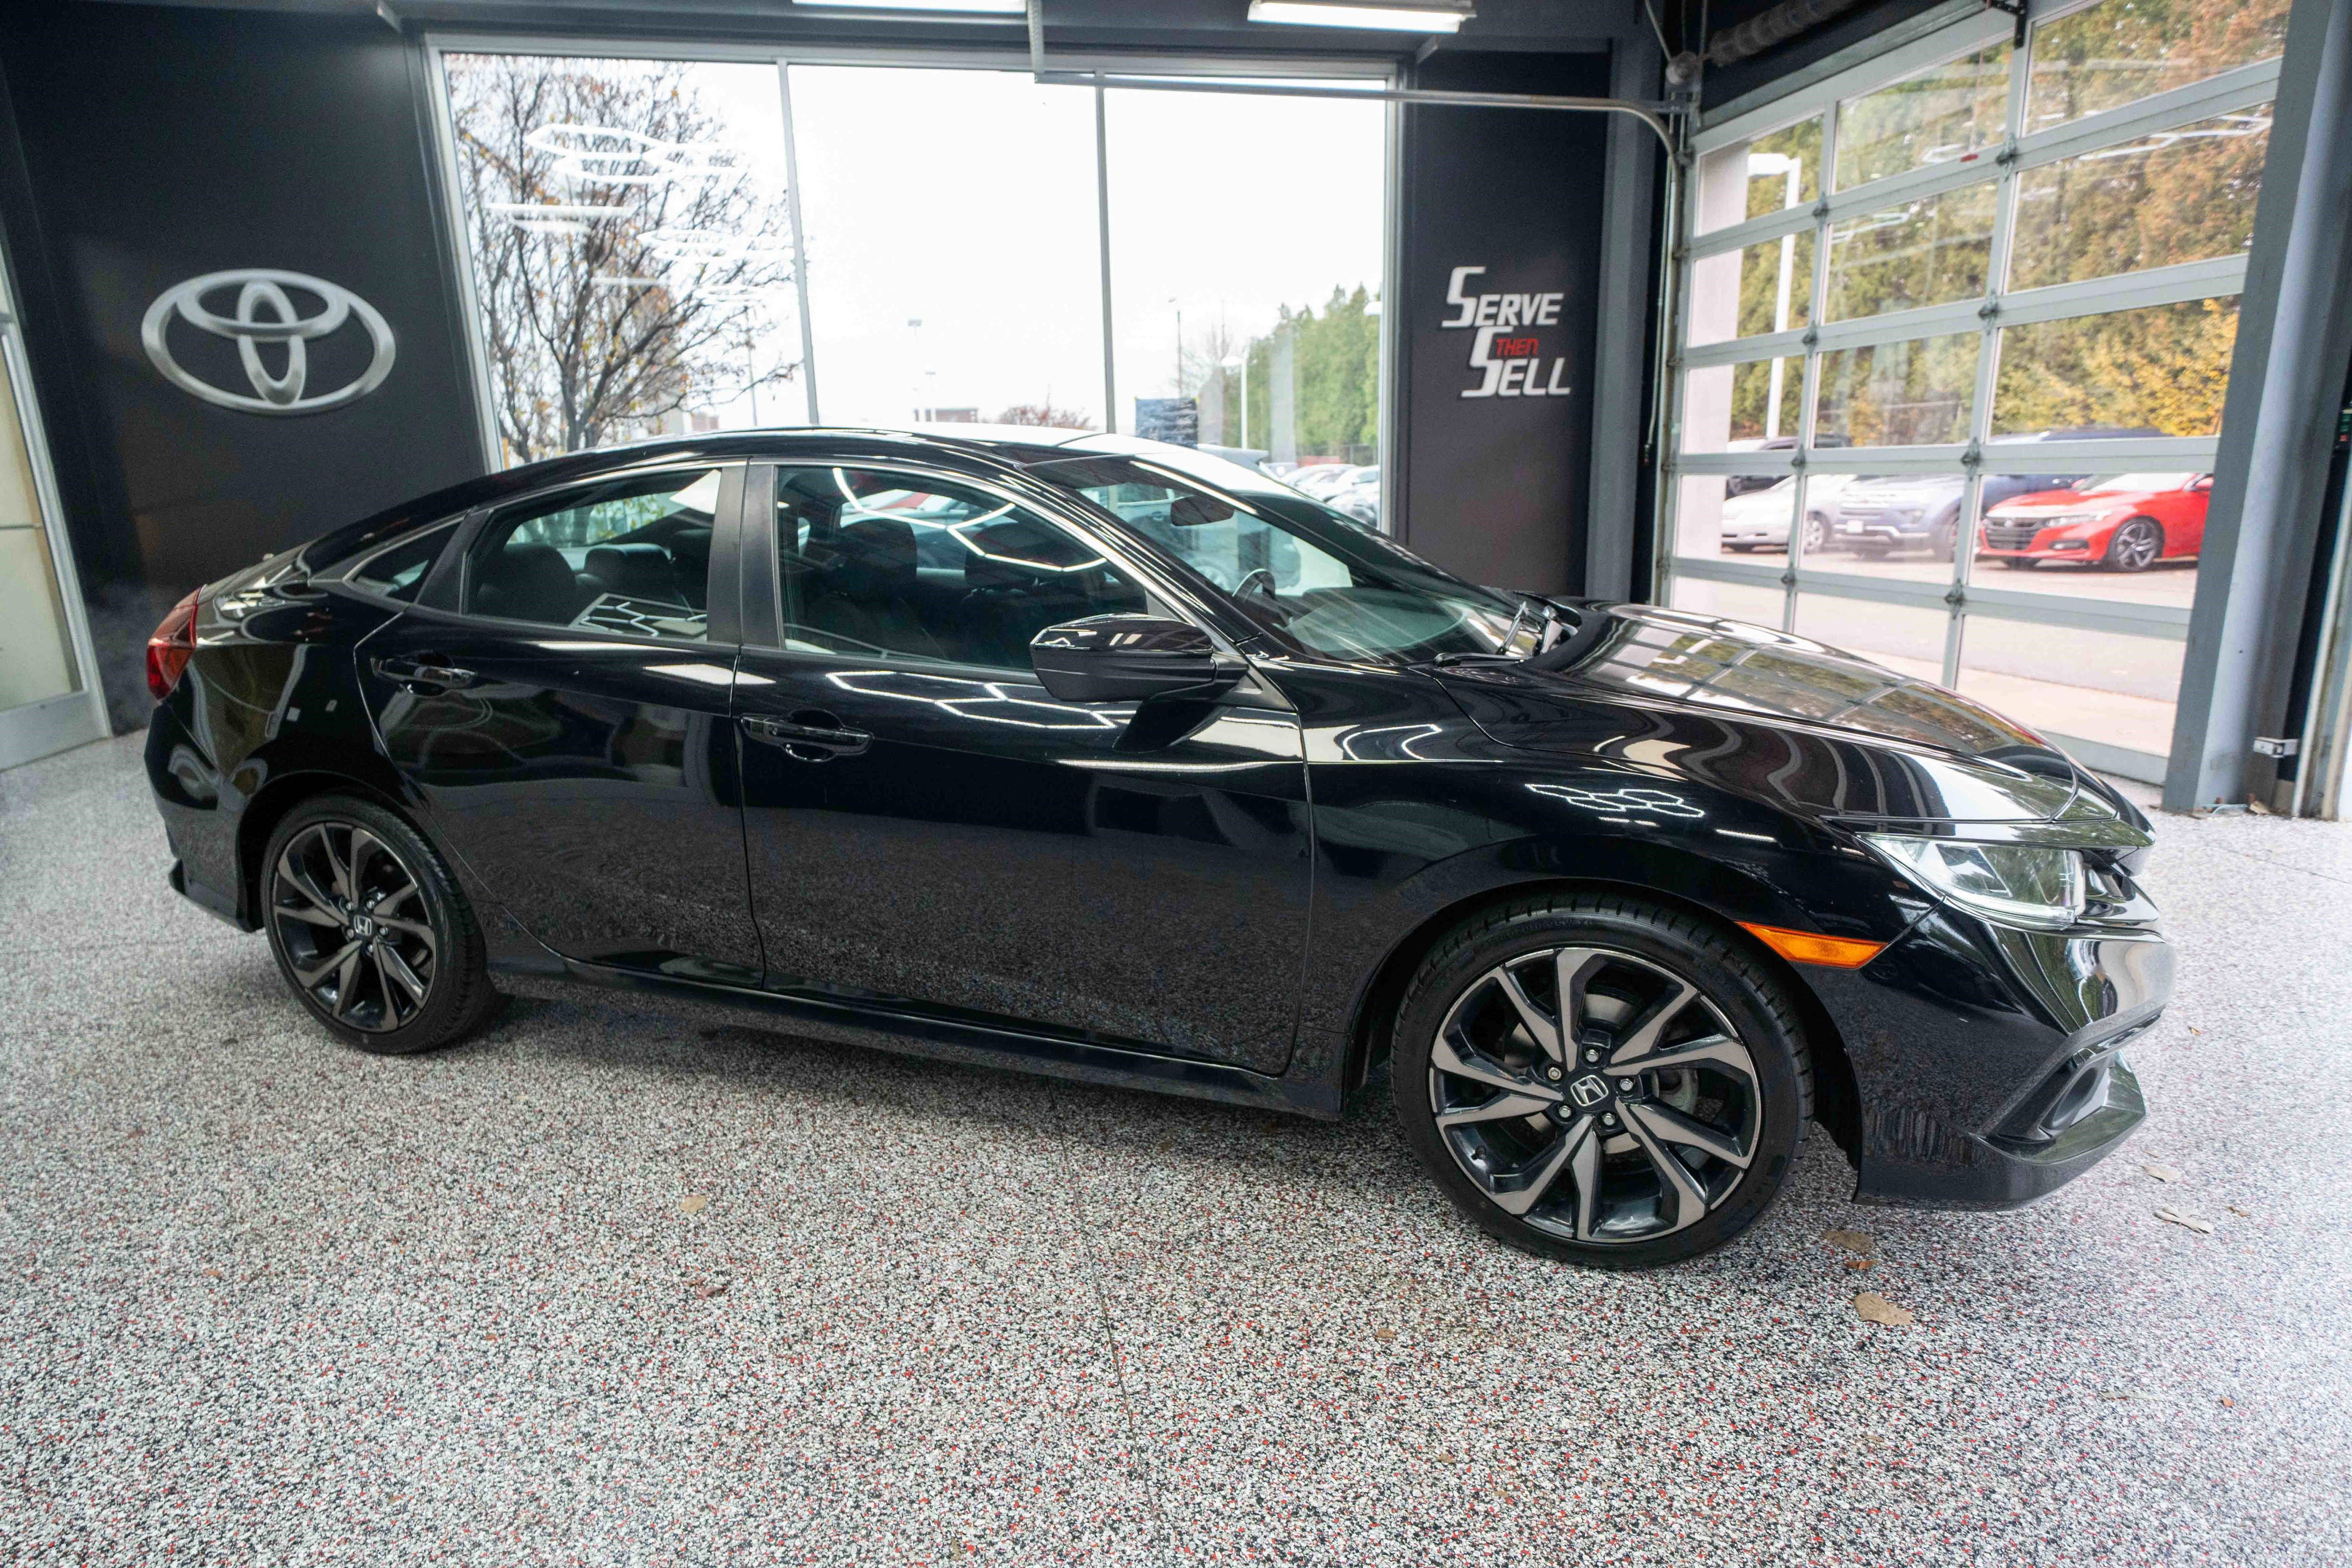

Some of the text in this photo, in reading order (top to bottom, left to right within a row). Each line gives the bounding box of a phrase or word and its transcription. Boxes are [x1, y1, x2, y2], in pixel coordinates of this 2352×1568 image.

[1441, 266, 1565, 327] SERVE
[1461, 325, 1571, 397] SELL
[1496, 338, 1539, 356] THEN
